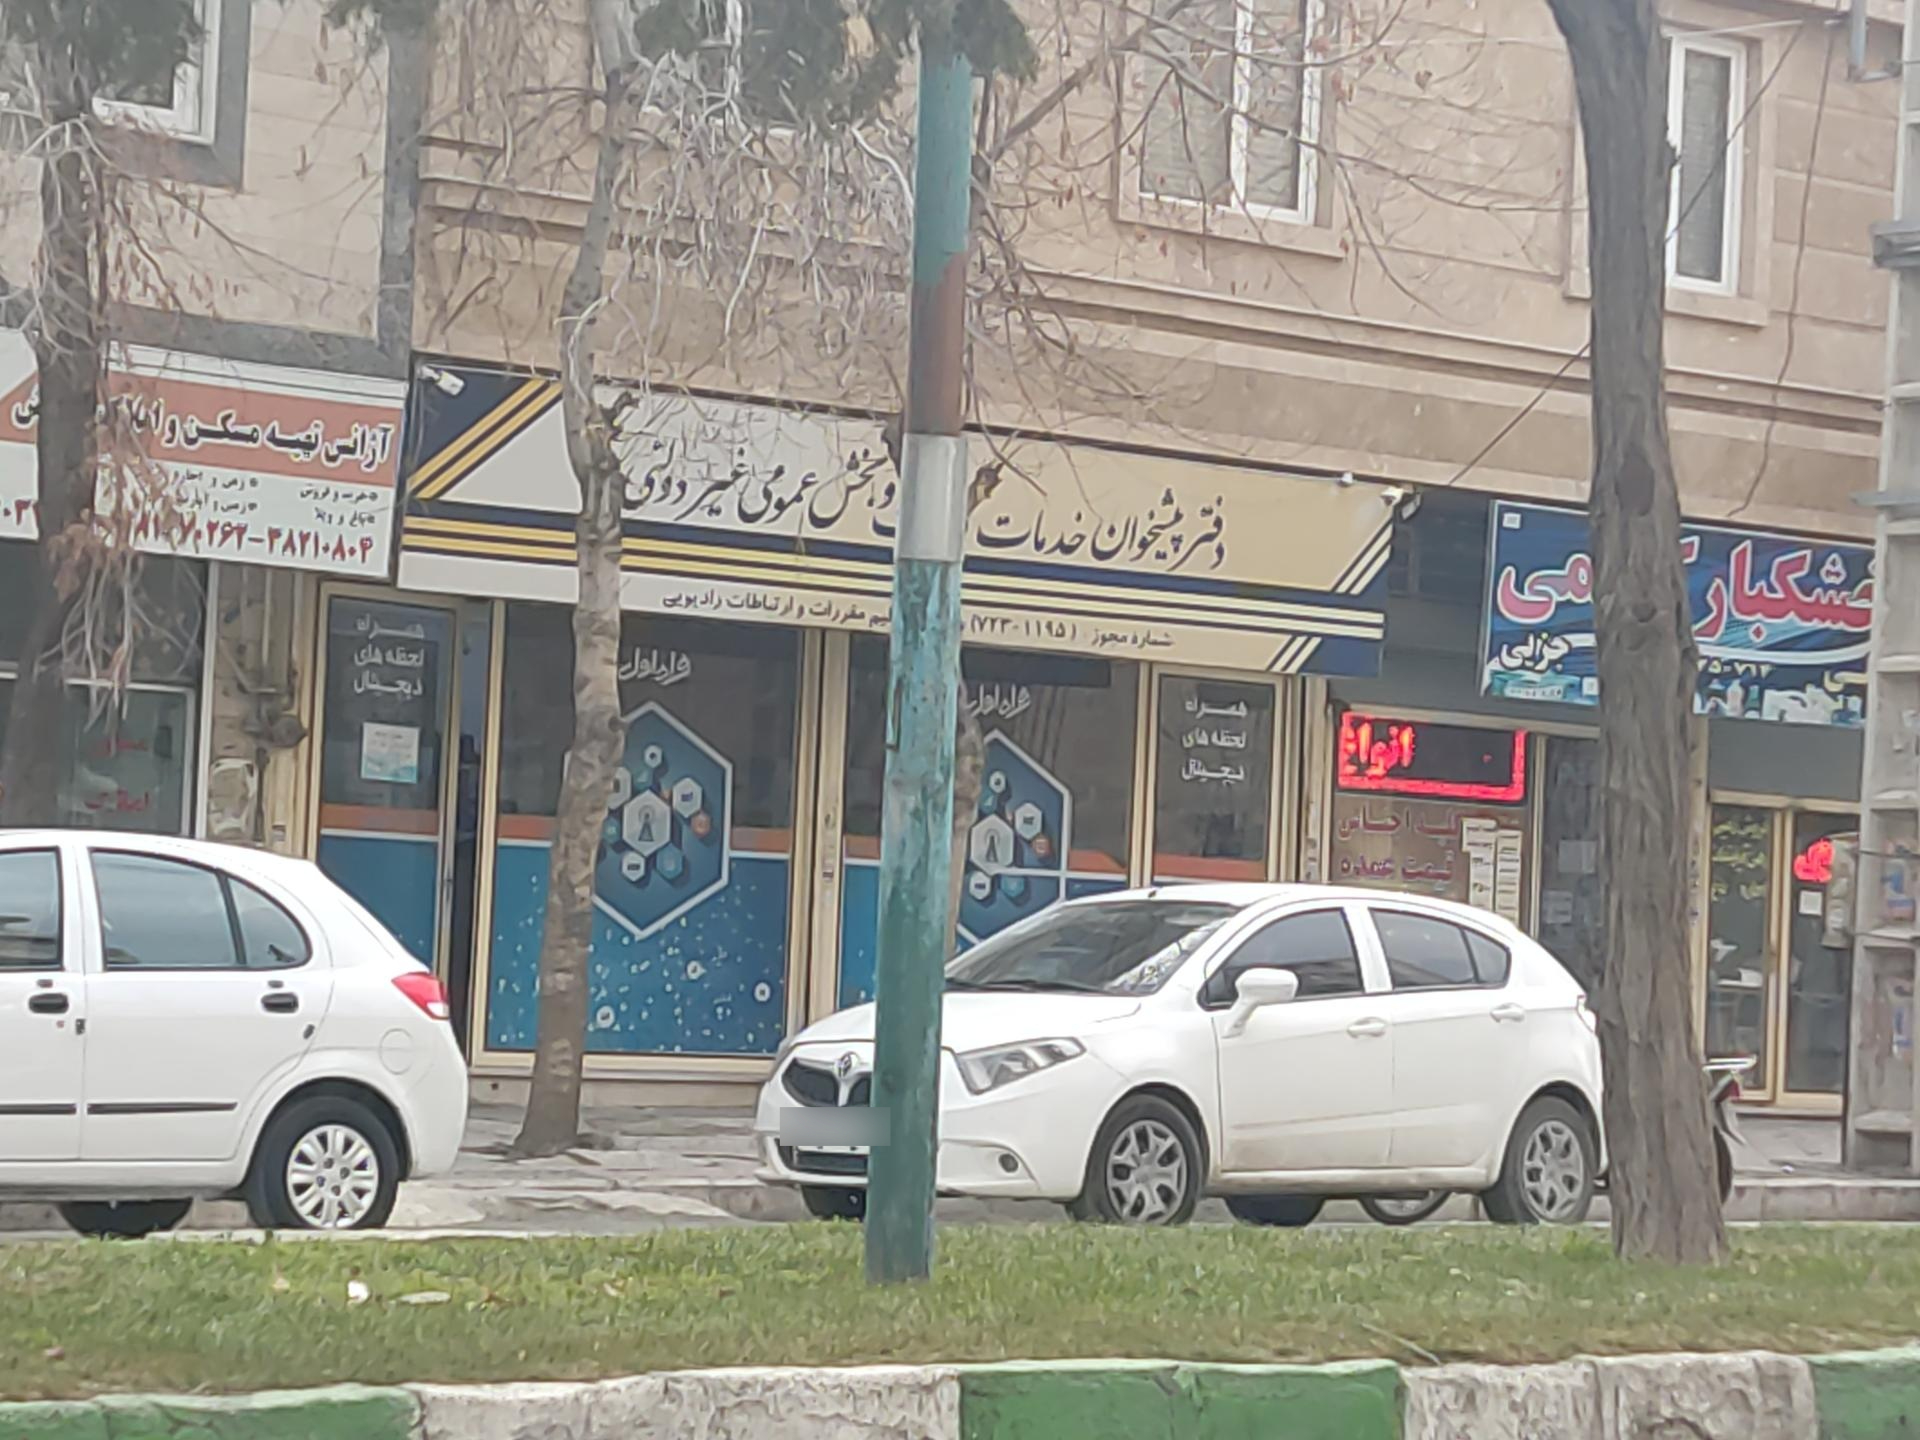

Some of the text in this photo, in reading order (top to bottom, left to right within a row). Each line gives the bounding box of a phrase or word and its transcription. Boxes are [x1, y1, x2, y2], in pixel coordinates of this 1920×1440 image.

[162, 414, 181, 446] و
[180, 408, 261, 451] مسکن
[737, 464, 818, 524] عمومی
[808, 448, 889, 529] بخش
[877, 481, 896, 510] و
[976, 509, 1086, 554] خدمات
[1090, 487, 1184, 563] پیشخوان
[1166, 495, 1225, 572] دفتر
[662, 588, 723, 611] رادیویی
[725, 591, 794, 617] ارتباطات
[796, 601, 804, 618] و
[809, 601, 866, 626] مقررات
[1090, 627, 1129, 647] مجوز
[1130, 628, 1175, 648] شماره
